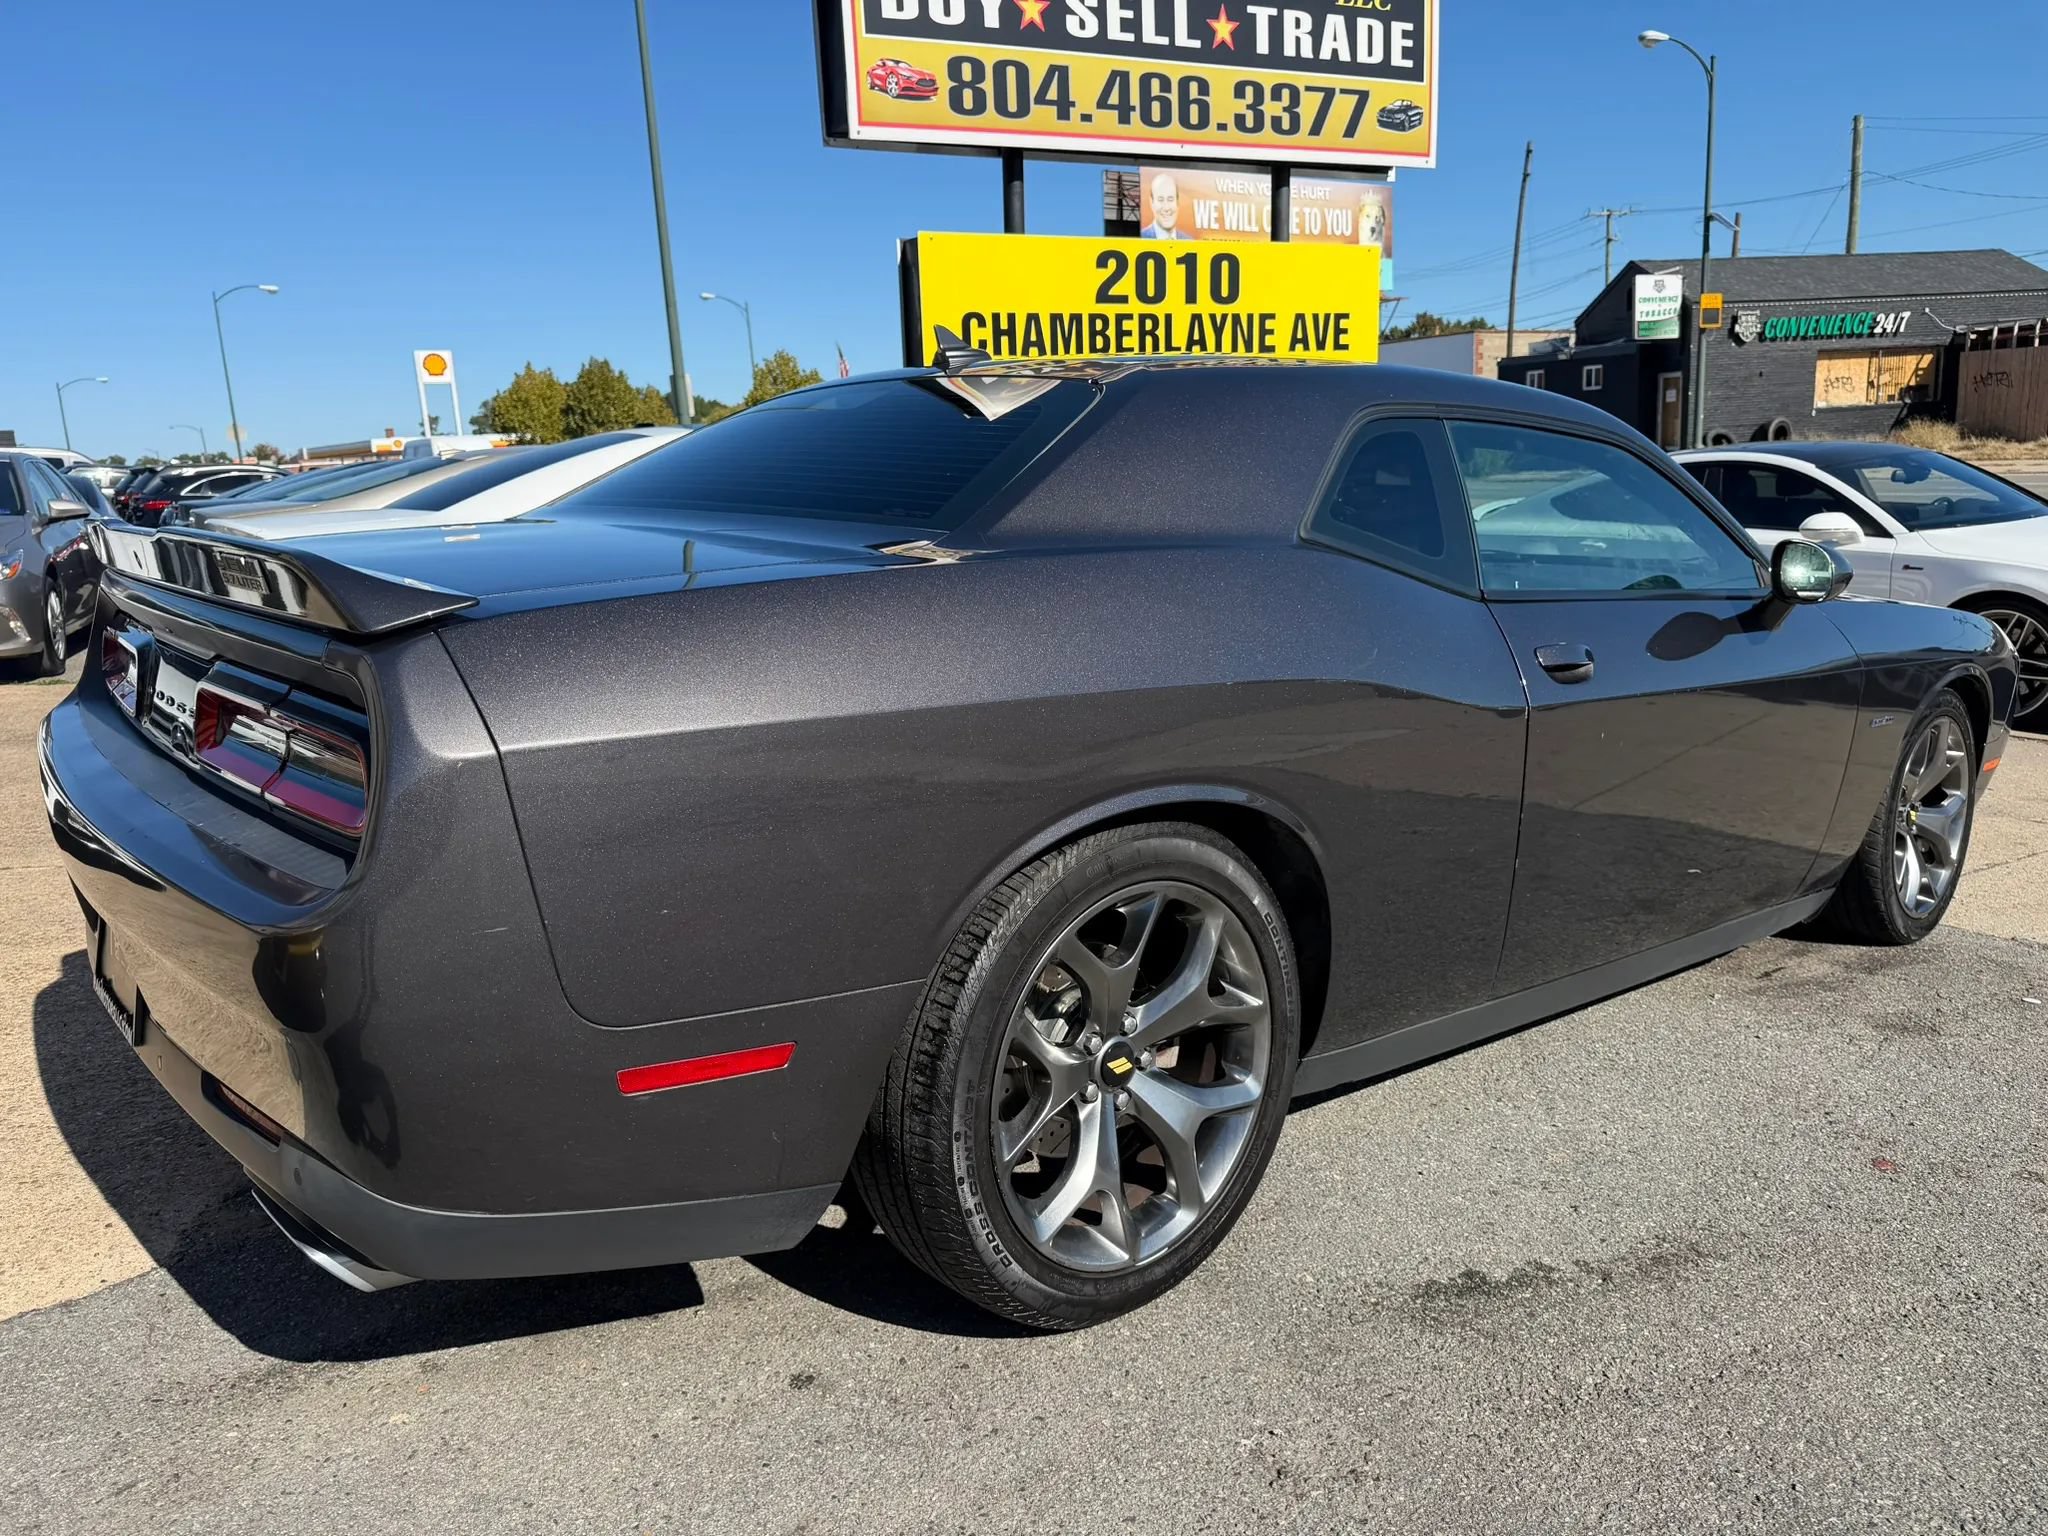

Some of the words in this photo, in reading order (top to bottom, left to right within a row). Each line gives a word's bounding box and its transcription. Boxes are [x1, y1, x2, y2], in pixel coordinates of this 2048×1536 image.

[1065, 0, 1201, 49] SELL
[1246, 5, 1414, 68] TRADE
[947, 56, 1370, 138] 804.466.3377
[1216, 178, 1254, 197] WHEN
[1301, 185, 1330, 201] HURT
[1194, 199, 1219, 230] WE
[1222, 200, 1259, 233] WILL
[1303, 206, 1322, 236] TO
[1324, 207, 1352, 237] YOU
[1095, 249, 1240, 305] 2010
[1639, 307, 1679, 318] TOBACCO
[1764, 311, 1876, 338] CONVENIENCE
[1873, 311, 1911, 334] 24/7
[961, 311, 1276, 357] CHAMBERLAYNE
[1288, 312, 1350, 353] AVE
